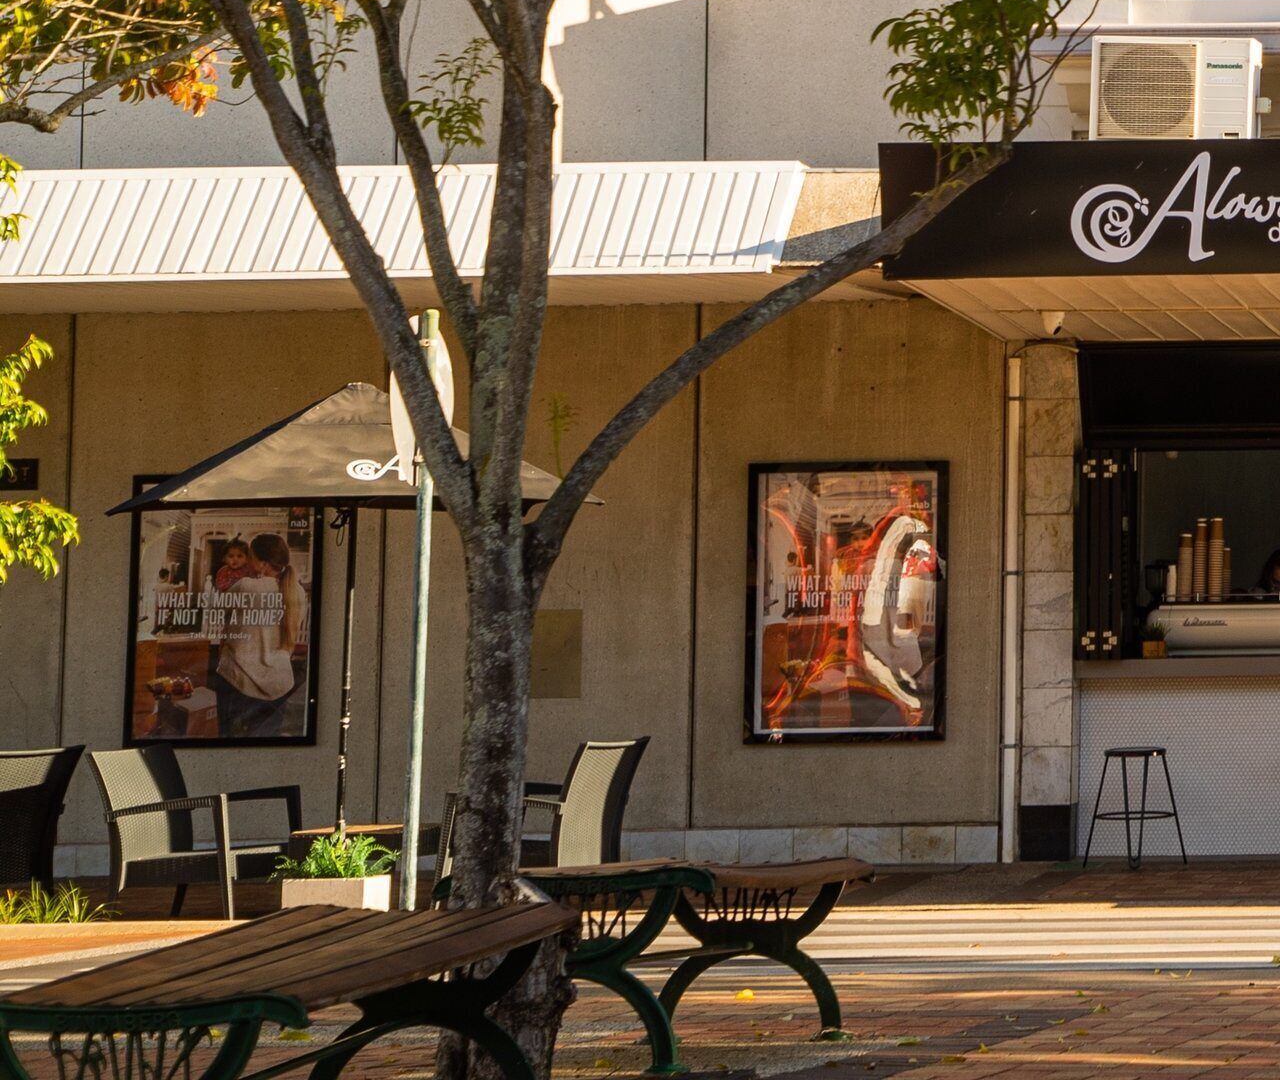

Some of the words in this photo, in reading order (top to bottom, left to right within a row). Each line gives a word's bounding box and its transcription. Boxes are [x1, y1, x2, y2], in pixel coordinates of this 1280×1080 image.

[290, 519, 308, 528] nab
[157, 592, 193, 608] WHAT
[197, 592, 209, 608] IS
[213, 592, 257, 608] MONEY
[261, 592, 286, 610] FOR,
[803, 591, 826, 608] NOT
[158, 609, 170, 625] IF
[173, 609, 198, 625] NOT
[202, 609, 225, 625] FOR
[230, 609, 238, 625] A
[242, 609, 285, 625] HOME?
[229, 632, 252, 641] today
